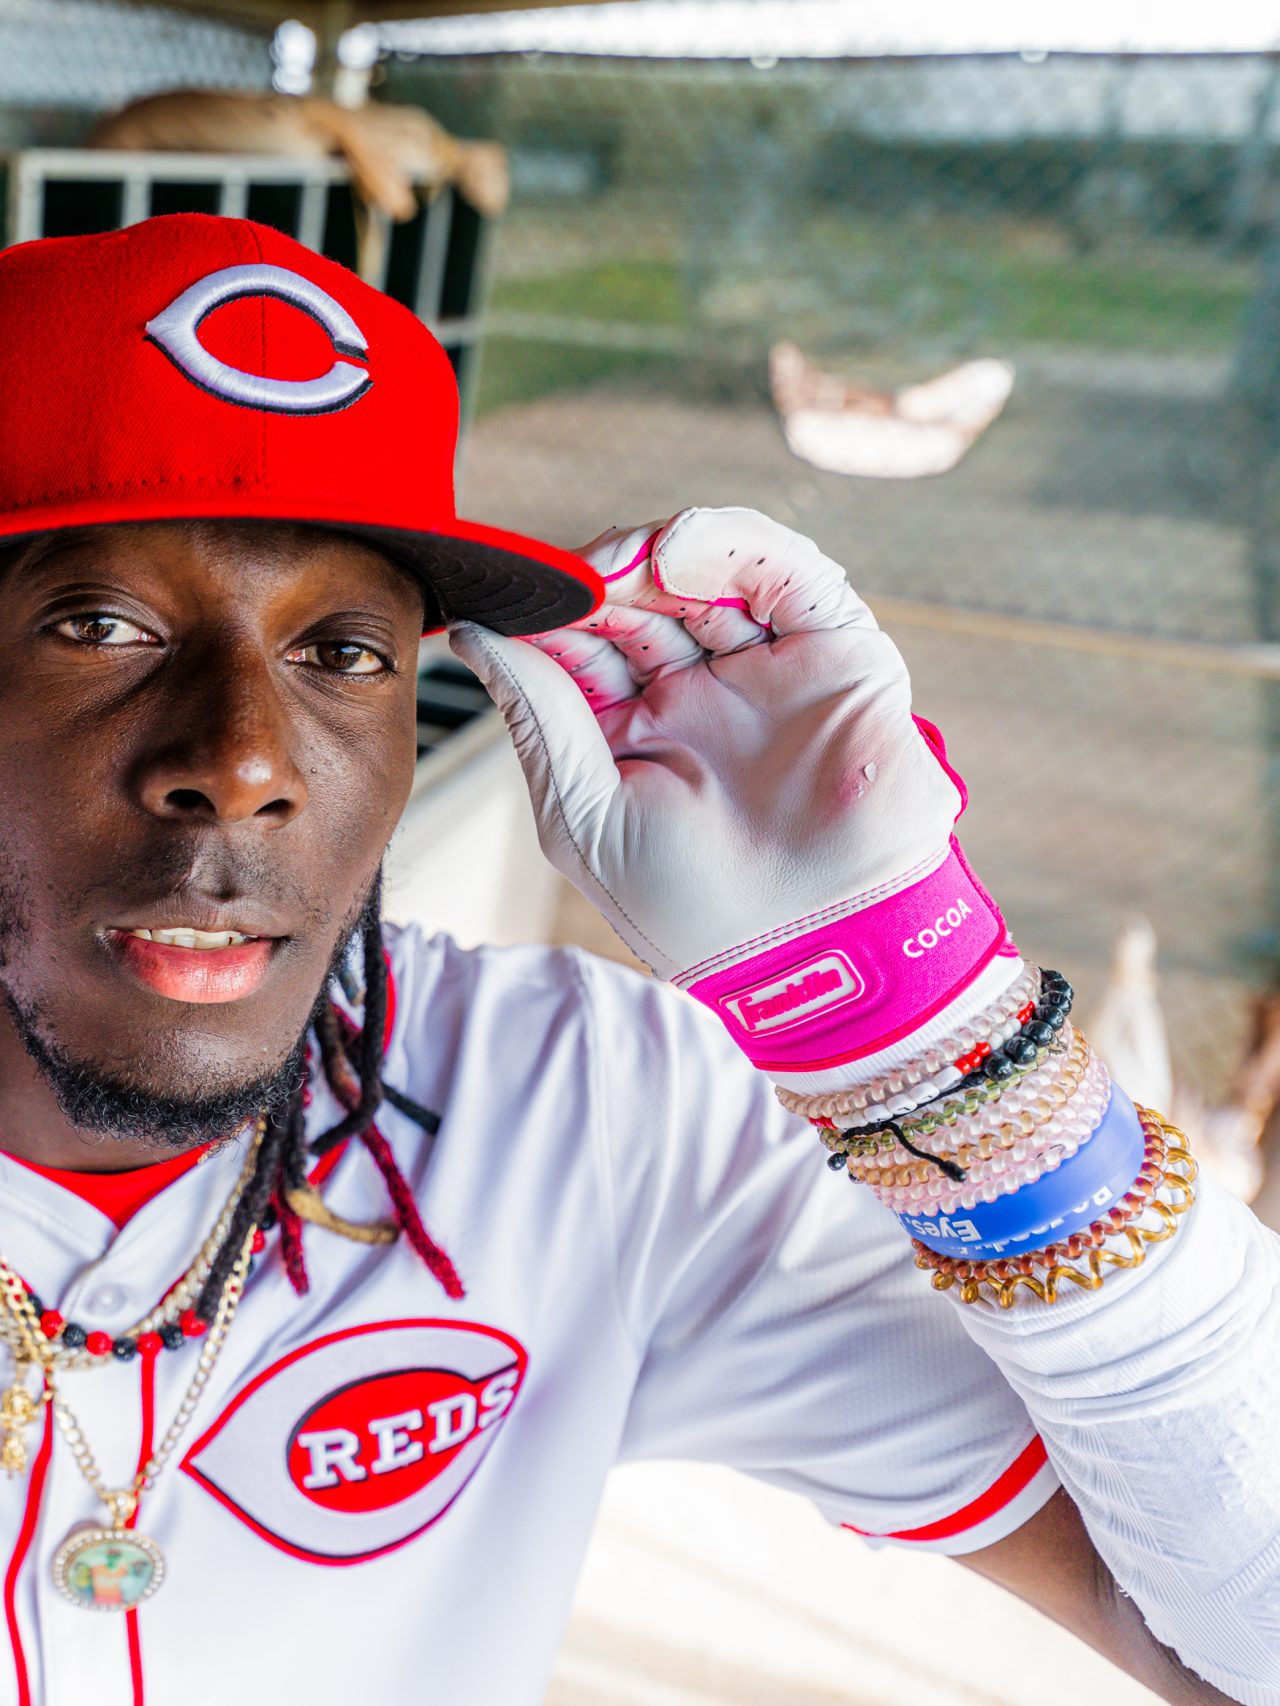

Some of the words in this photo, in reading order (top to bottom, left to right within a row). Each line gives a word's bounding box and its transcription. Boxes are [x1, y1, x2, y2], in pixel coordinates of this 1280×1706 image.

[142, 263, 374, 417] C
[902, 898, 973, 959] COCOA
[738, 968, 844, 1031] Franklin
[296, 1369, 520, 1491] REDS
